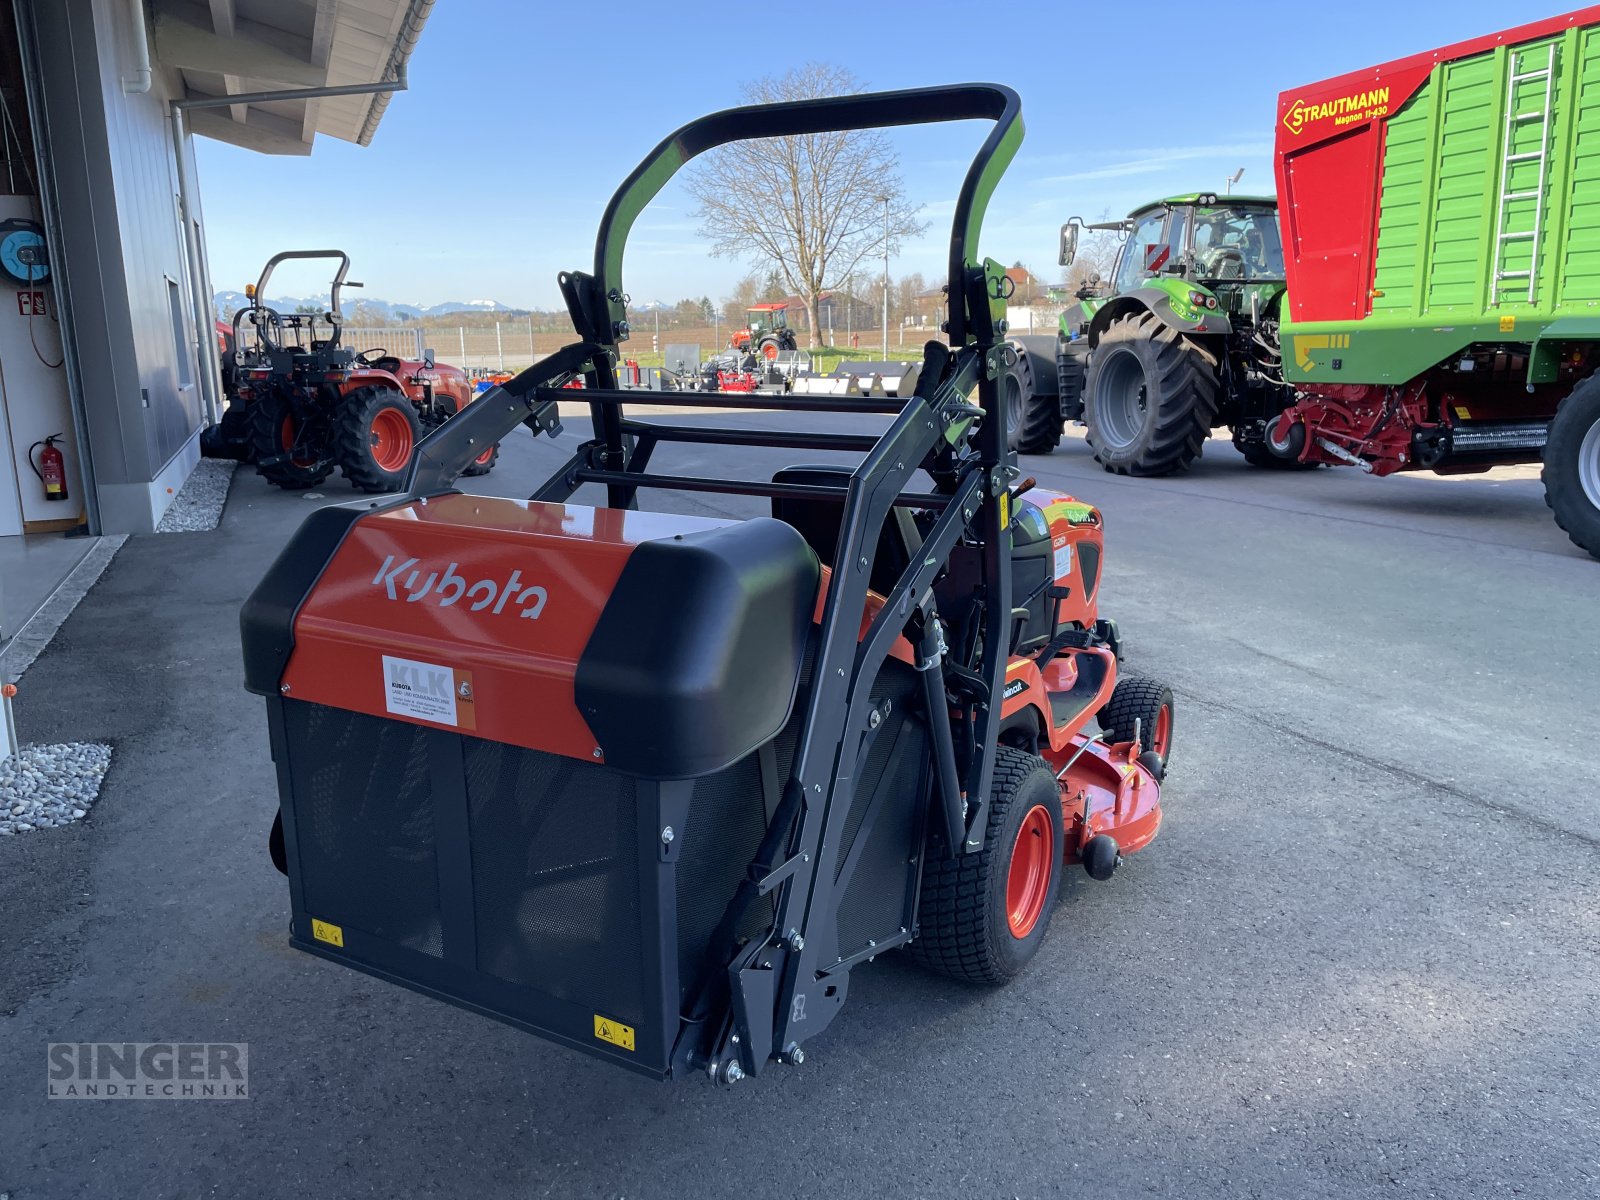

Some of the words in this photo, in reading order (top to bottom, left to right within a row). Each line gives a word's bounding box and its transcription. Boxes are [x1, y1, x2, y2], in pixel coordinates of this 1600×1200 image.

[1292, 87, 1390, 127] STRAUTMANN
[1335, 111, 1363, 126] Magnon
[372, 555, 548, 620] Kubota
[390, 664, 450, 699] KLK
[391, 682, 412, 691] KUBOTA
